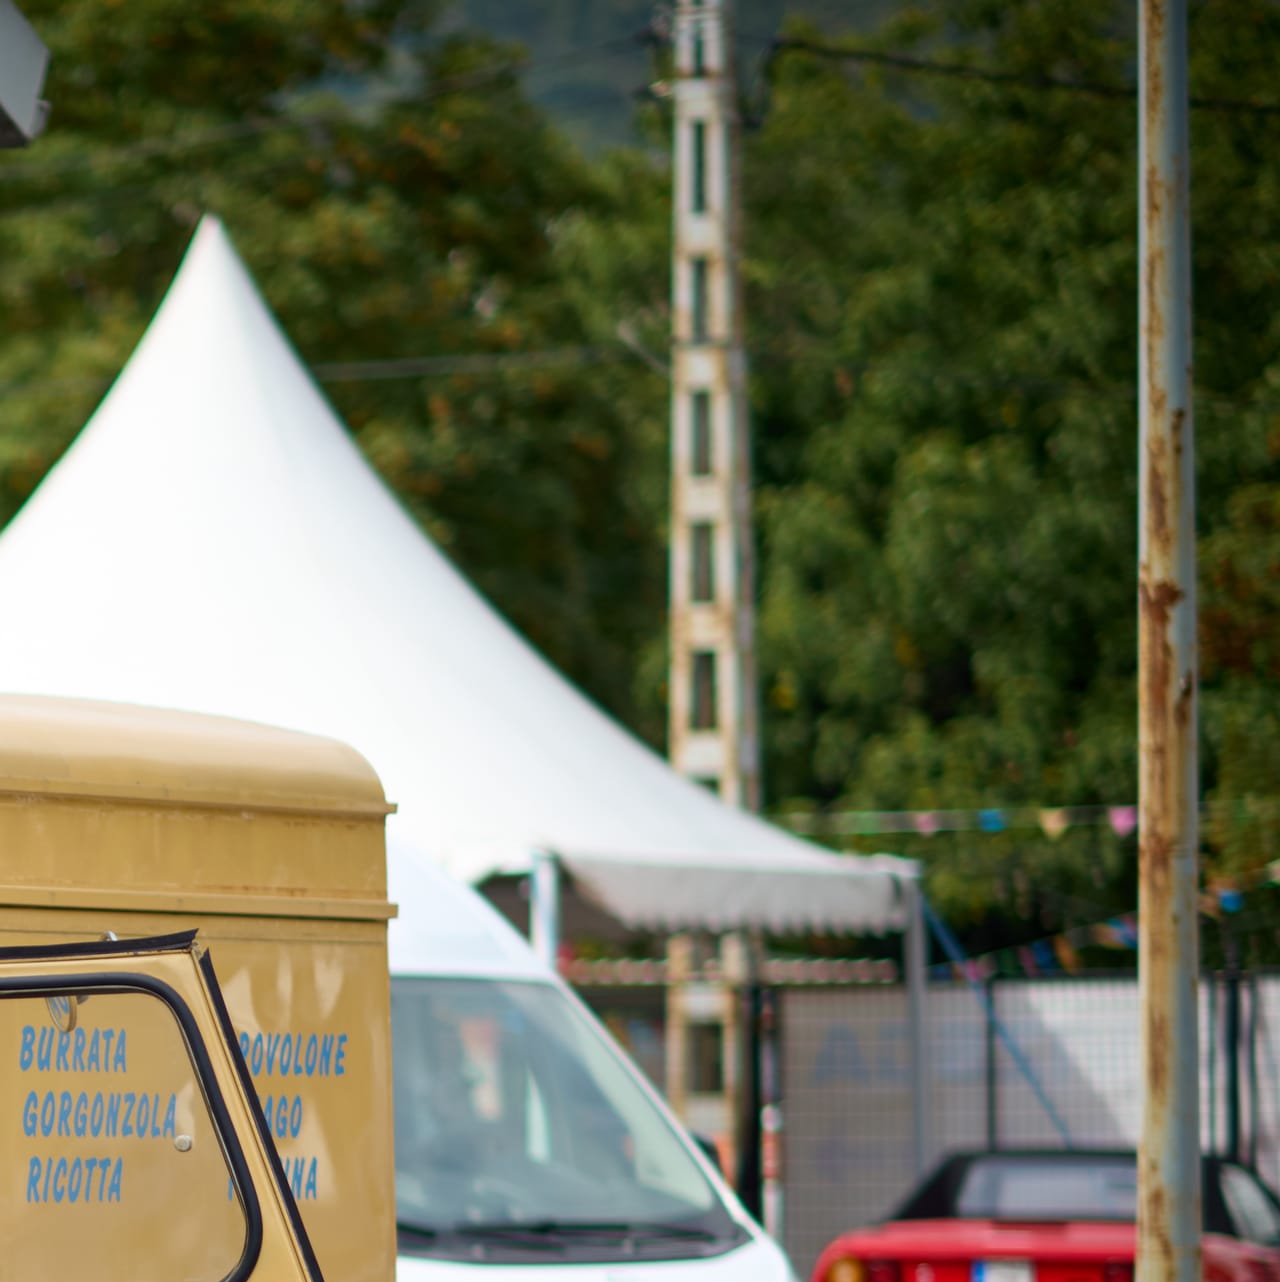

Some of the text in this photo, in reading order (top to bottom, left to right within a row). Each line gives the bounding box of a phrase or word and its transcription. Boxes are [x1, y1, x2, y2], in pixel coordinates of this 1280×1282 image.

[19, 1026, 128, 1074] BURRATA
[22, 1092, 177, 1140] GORGONZOLA
[26, 1156, 123, 1204] RICOTTA
